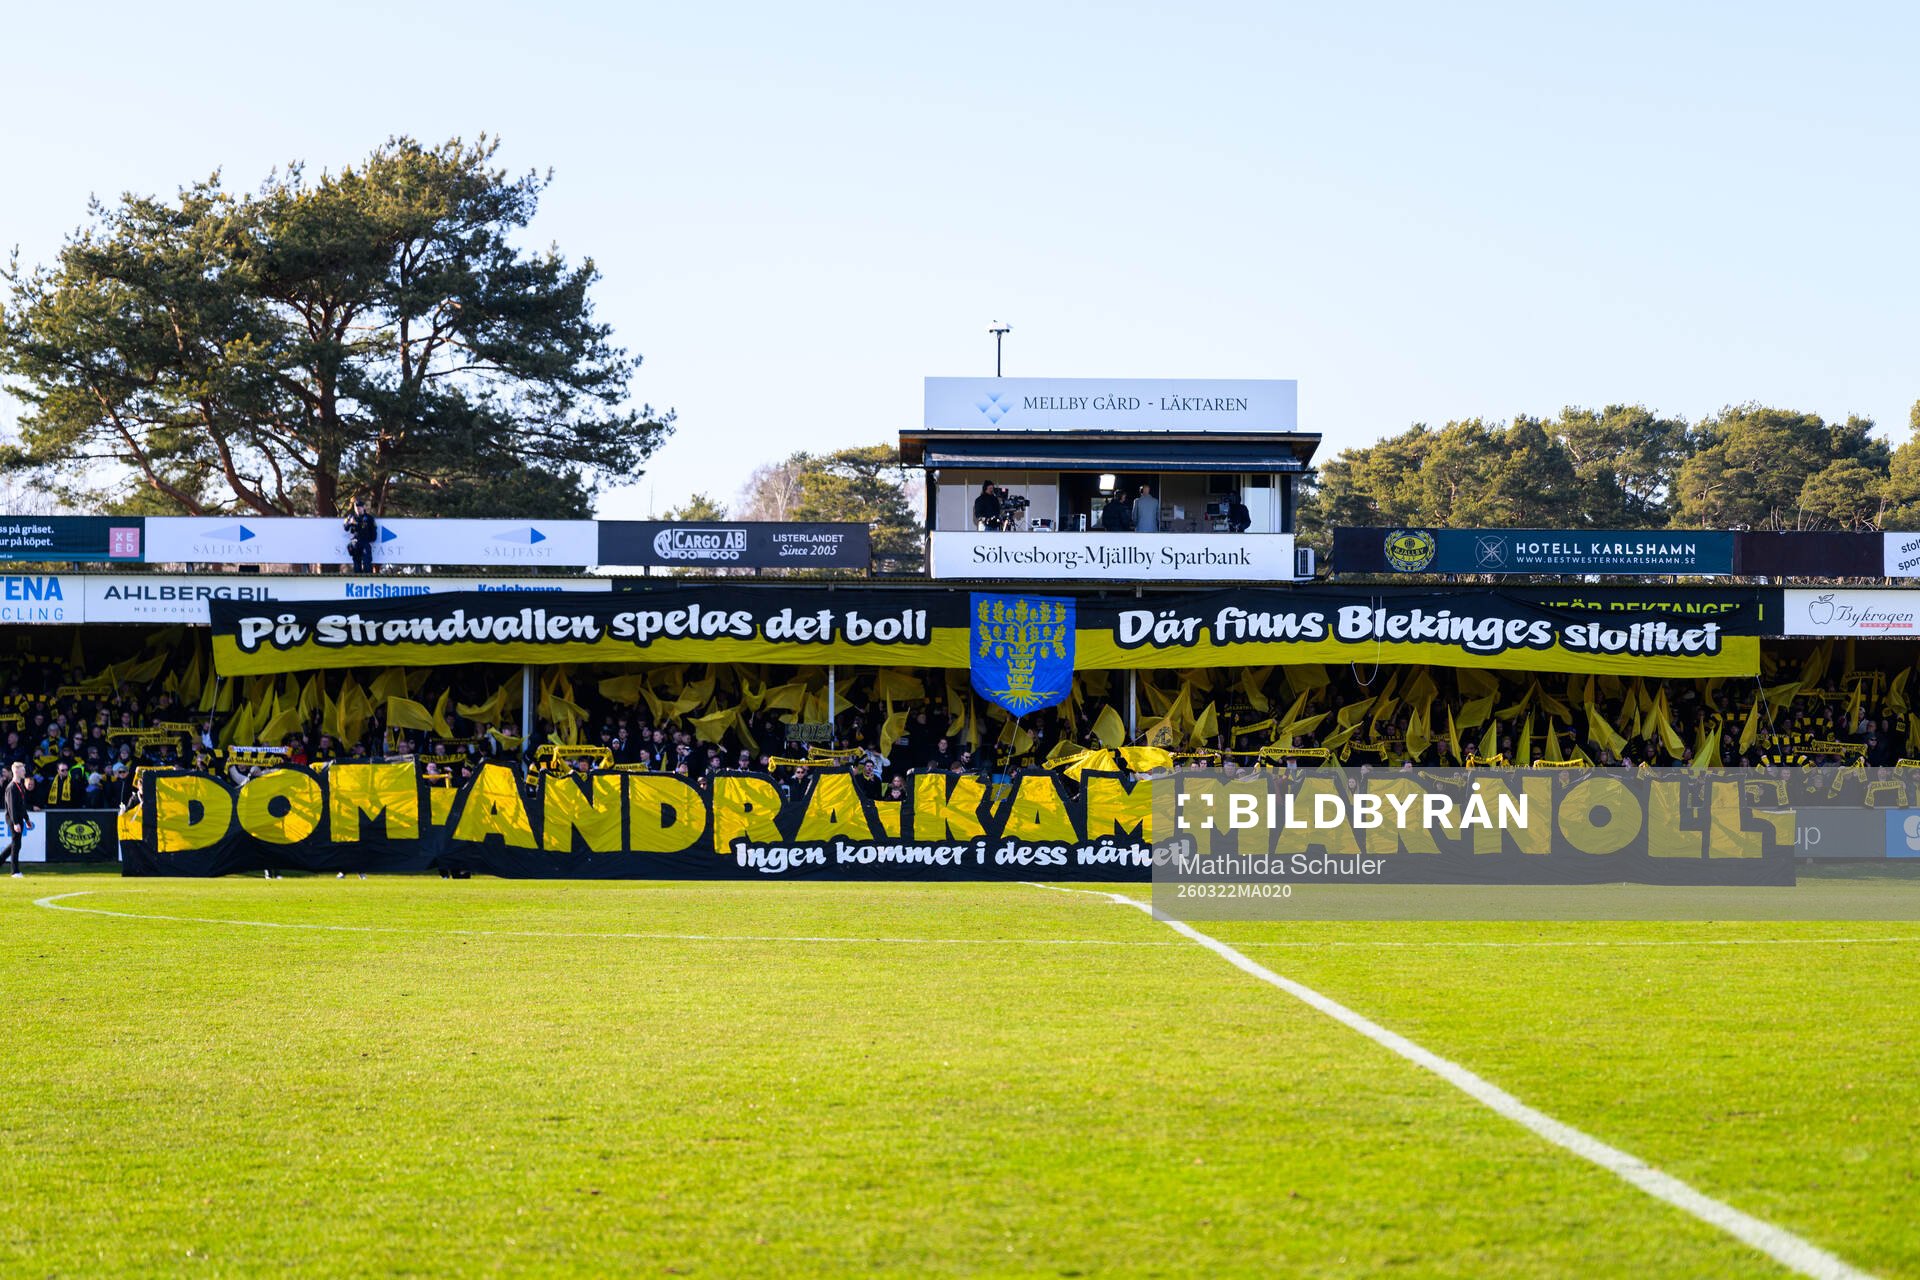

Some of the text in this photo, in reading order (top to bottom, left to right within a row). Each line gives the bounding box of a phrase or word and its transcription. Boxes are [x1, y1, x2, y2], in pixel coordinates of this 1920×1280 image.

[1023, 396, 1089, 410] MELLBY
[1093, 393, 1141, 410] GÅRD
[1160, 394, 1249, 411] LÄKTAREN
[9, 524, 21, 536] på
[22, 524, 55, 536] gräset.
[10, 537, 22, 548] på
[23, 537, 54, 548] köpet.
[675, 531, 744, 549] CARGO AB
[772, 534, 844, 543] LISTERLANDET
[779, 544, 838, 557] Since 2005
[1516, 543, 1696, 555] HOTELL KARLSHAMN
[972, 545, 1251, 570] Sölvesborg-Mjällby Sparbank
[1516, 556, 1696, 565] WWW.BESTWESTERNKARLSHAMN.SE
[346, 583, 431, 598] Karlshamns
[2, 607, 64, 621] CLING
[1836, 605, 1914, 632] Bykrogen
[238, 604, 927, 649] På Strandvallen spelas det boll
[1118, 610, 1202, 643] Där
[1214, 607, 1325, 641] finns
[1337, 605, 1551, 650] Blekinges
[155, 761, 420, 853] DOM
[452, 763, 875, 855] ANDRA
[1473, 776, 1763, 859] NOLL
[735, 842, 827, 873] Ingen
[836, 842, 968, 866] kommer
[976, 841, 986, 865] i
[995, 841, 1068, 866] dess
